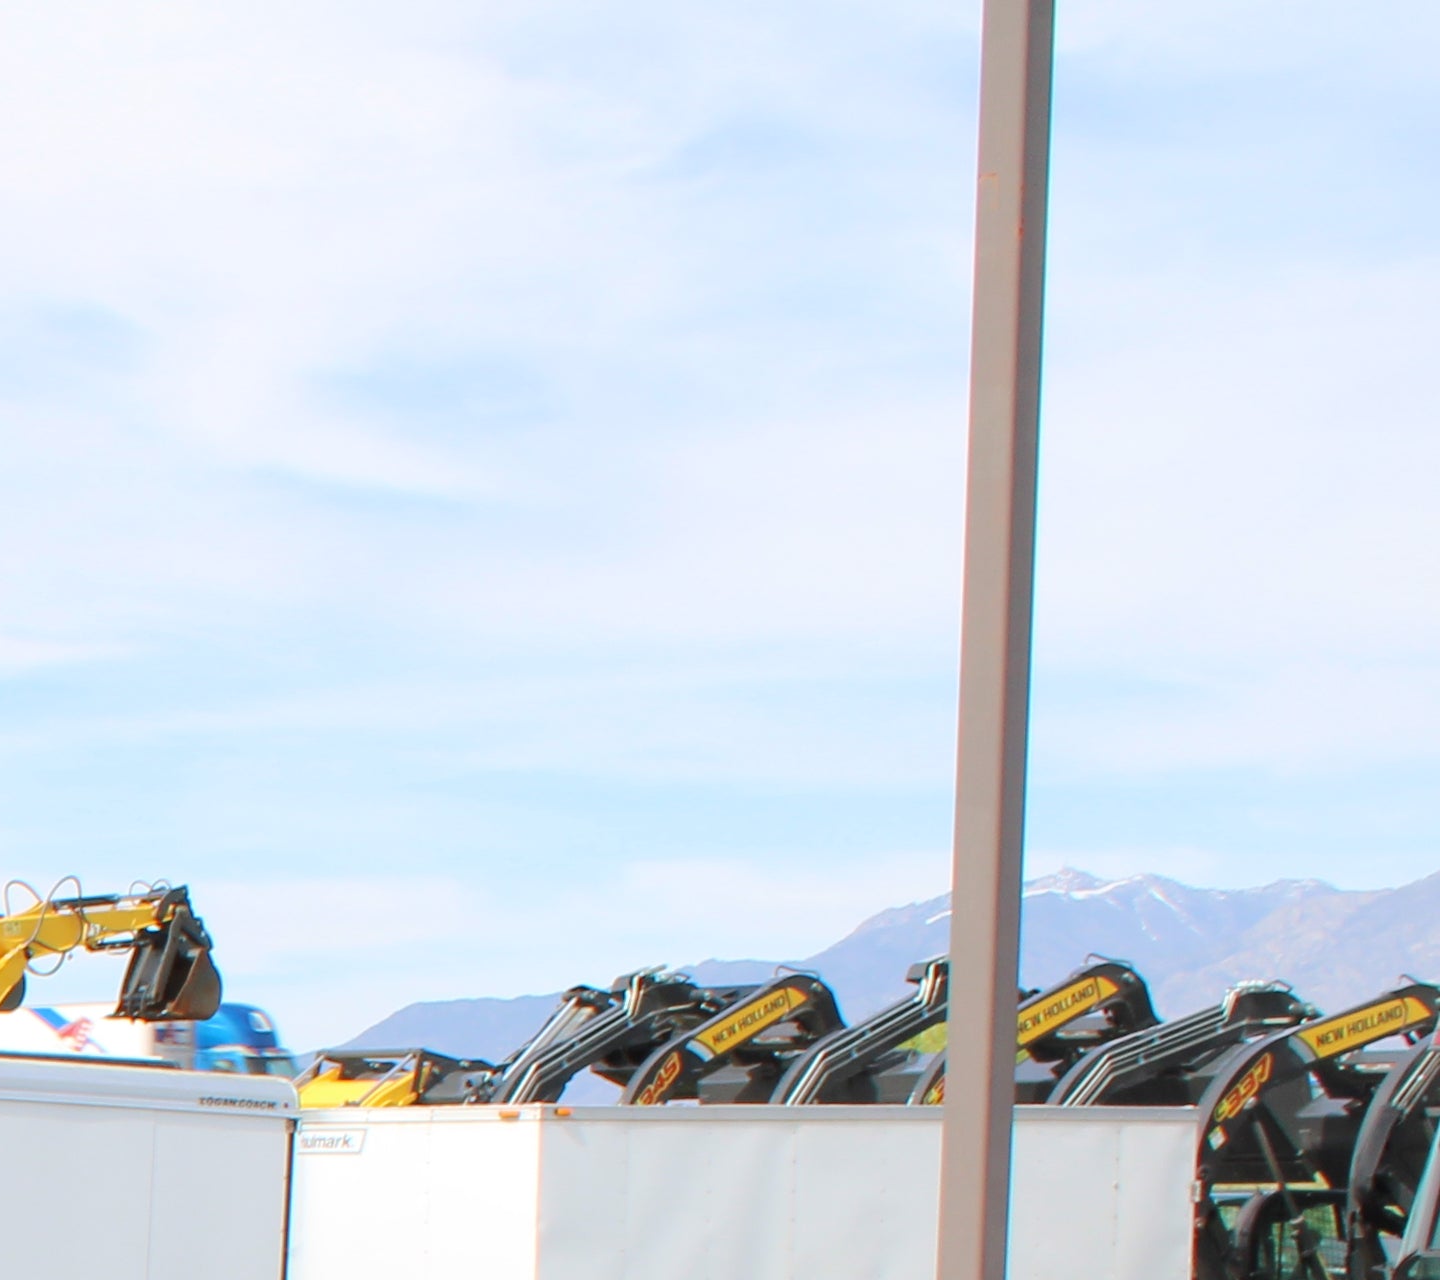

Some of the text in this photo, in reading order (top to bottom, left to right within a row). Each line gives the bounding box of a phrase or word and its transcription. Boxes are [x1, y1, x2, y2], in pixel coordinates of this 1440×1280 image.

[711, 994, 786, 1046] NEW HOLLAND
[1043, 982, 1095, 1020] HOLLAND
[1315, 1005, 1403, 1048] NEW HOLLAND
